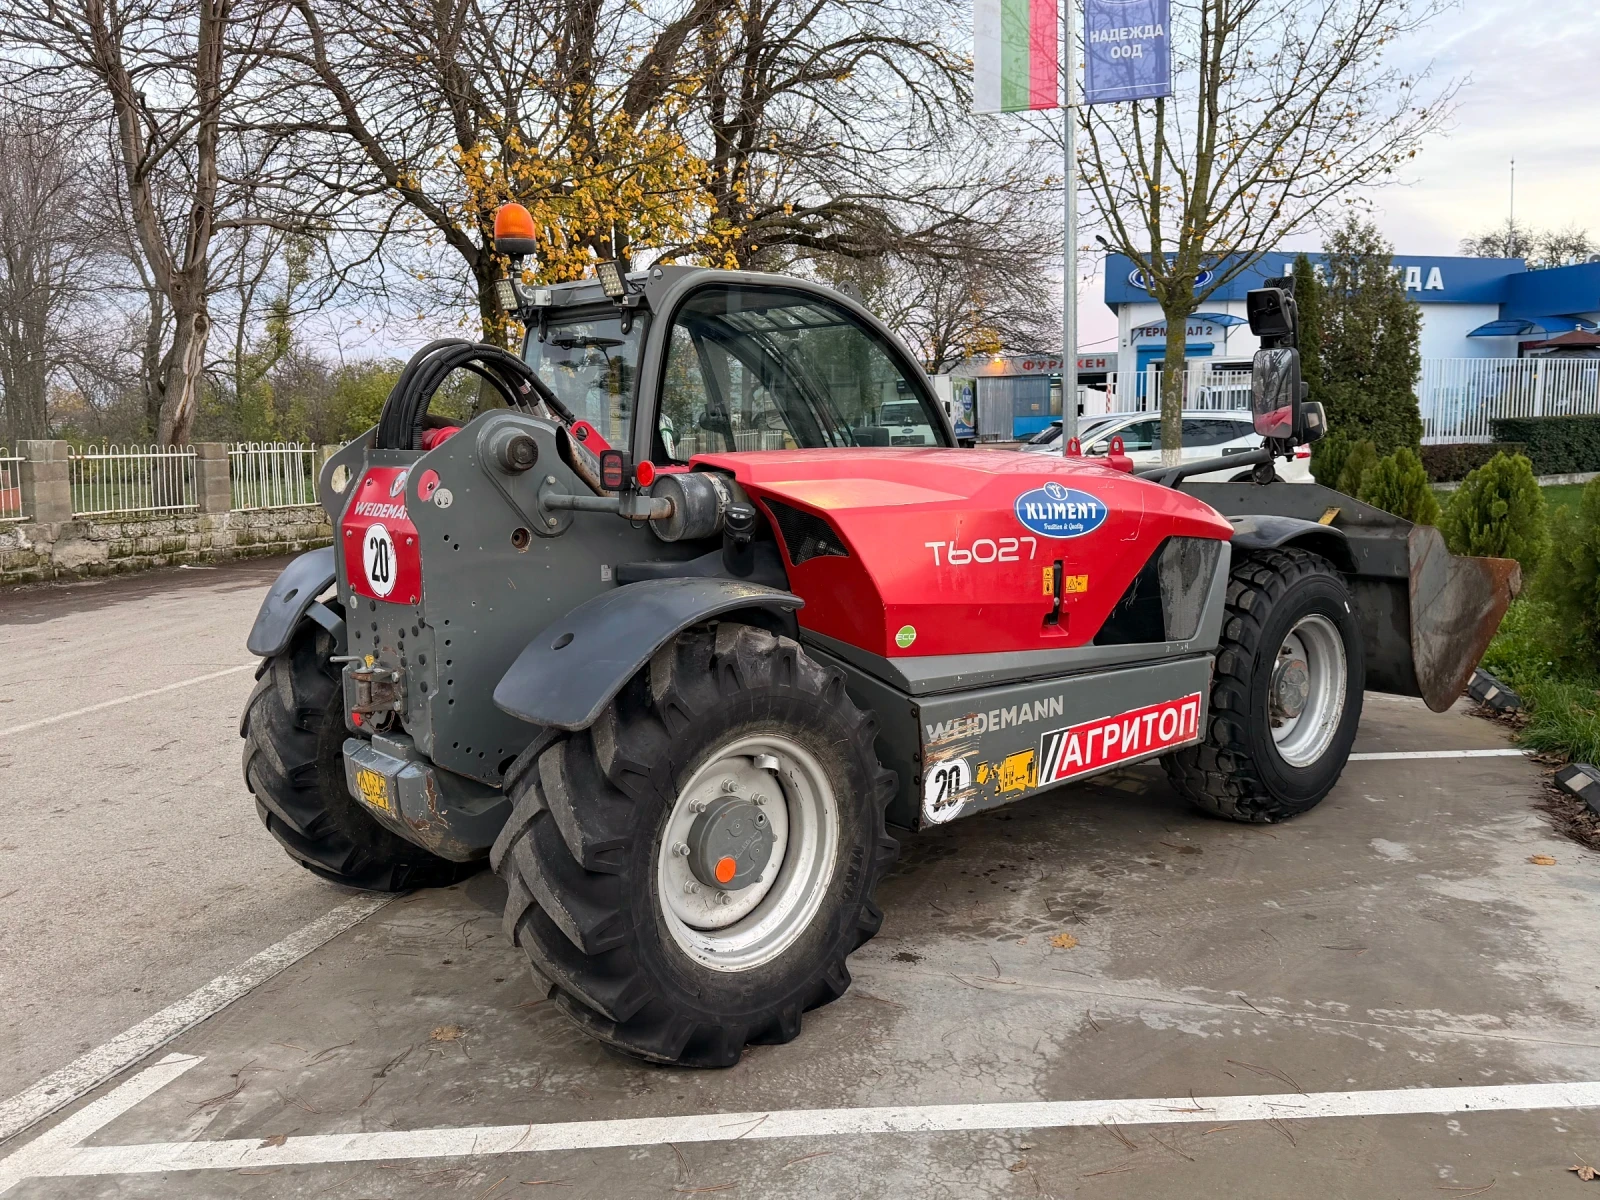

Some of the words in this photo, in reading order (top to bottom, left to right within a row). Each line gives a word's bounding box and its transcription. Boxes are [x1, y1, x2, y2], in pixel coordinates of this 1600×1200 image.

[1089, 23, 1165, 44] НАДЕЖДА
[1110, 44, 1143, 59] ООД
[1139, 326, 1203, 337] ТЕРМАЛ
[1205, 326, 1213, 336] 2
[1025, 502, 1097, 520] KLIMENT
[369, 536, 389, 583] 20
[924, 536, 1037, 566] T6027
[925, 695, 1064, 743] WEIDEMANN
[1061, 701, 1197, 772] АГРИТОП
[934, 764, 961, 814] 20
